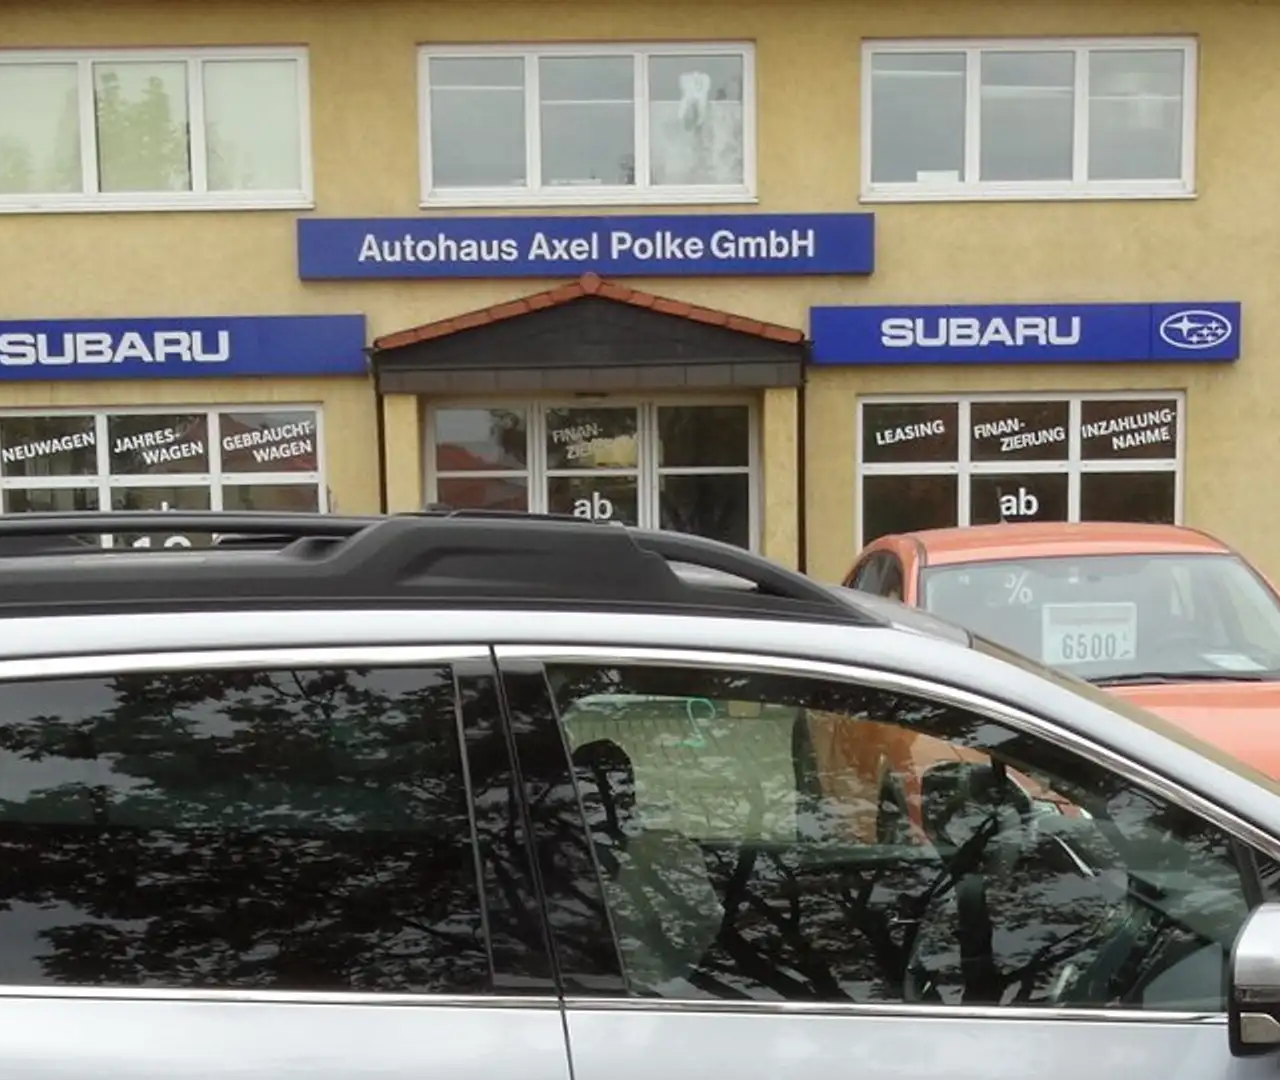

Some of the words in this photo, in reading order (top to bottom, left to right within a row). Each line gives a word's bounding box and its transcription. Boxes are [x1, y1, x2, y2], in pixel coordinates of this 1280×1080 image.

[358, 233, 518, 262] Autohaus
[528, 231, 599, 261] Axel
[611, 231, 704, 260] Polke
[710, 229, 815, 259] GmbH
[880, 316, 1081, 347] SUBARU
[223, 420, 315, 451] GEBRAUCHT-
[876, 420, 945, 446] LEASING
[974, 418, 1026, 440] FINAN-
[1081, 408, 1177, 439] INZAHLUNG-
[1, 431, 96, 463] NEUWAGEN
[114, 428, 181, 454] JAHRES-
[253, 440, 313, 463] WAGEN
[1000, 426, 1066, 452] ZIERUNG
[1112, 427, 1170, 451] NAHME
[142, 441, 204, 465] WAGEN
[573, 491, 613, 519] ab
[1000, 487, 1039, 516] ab
